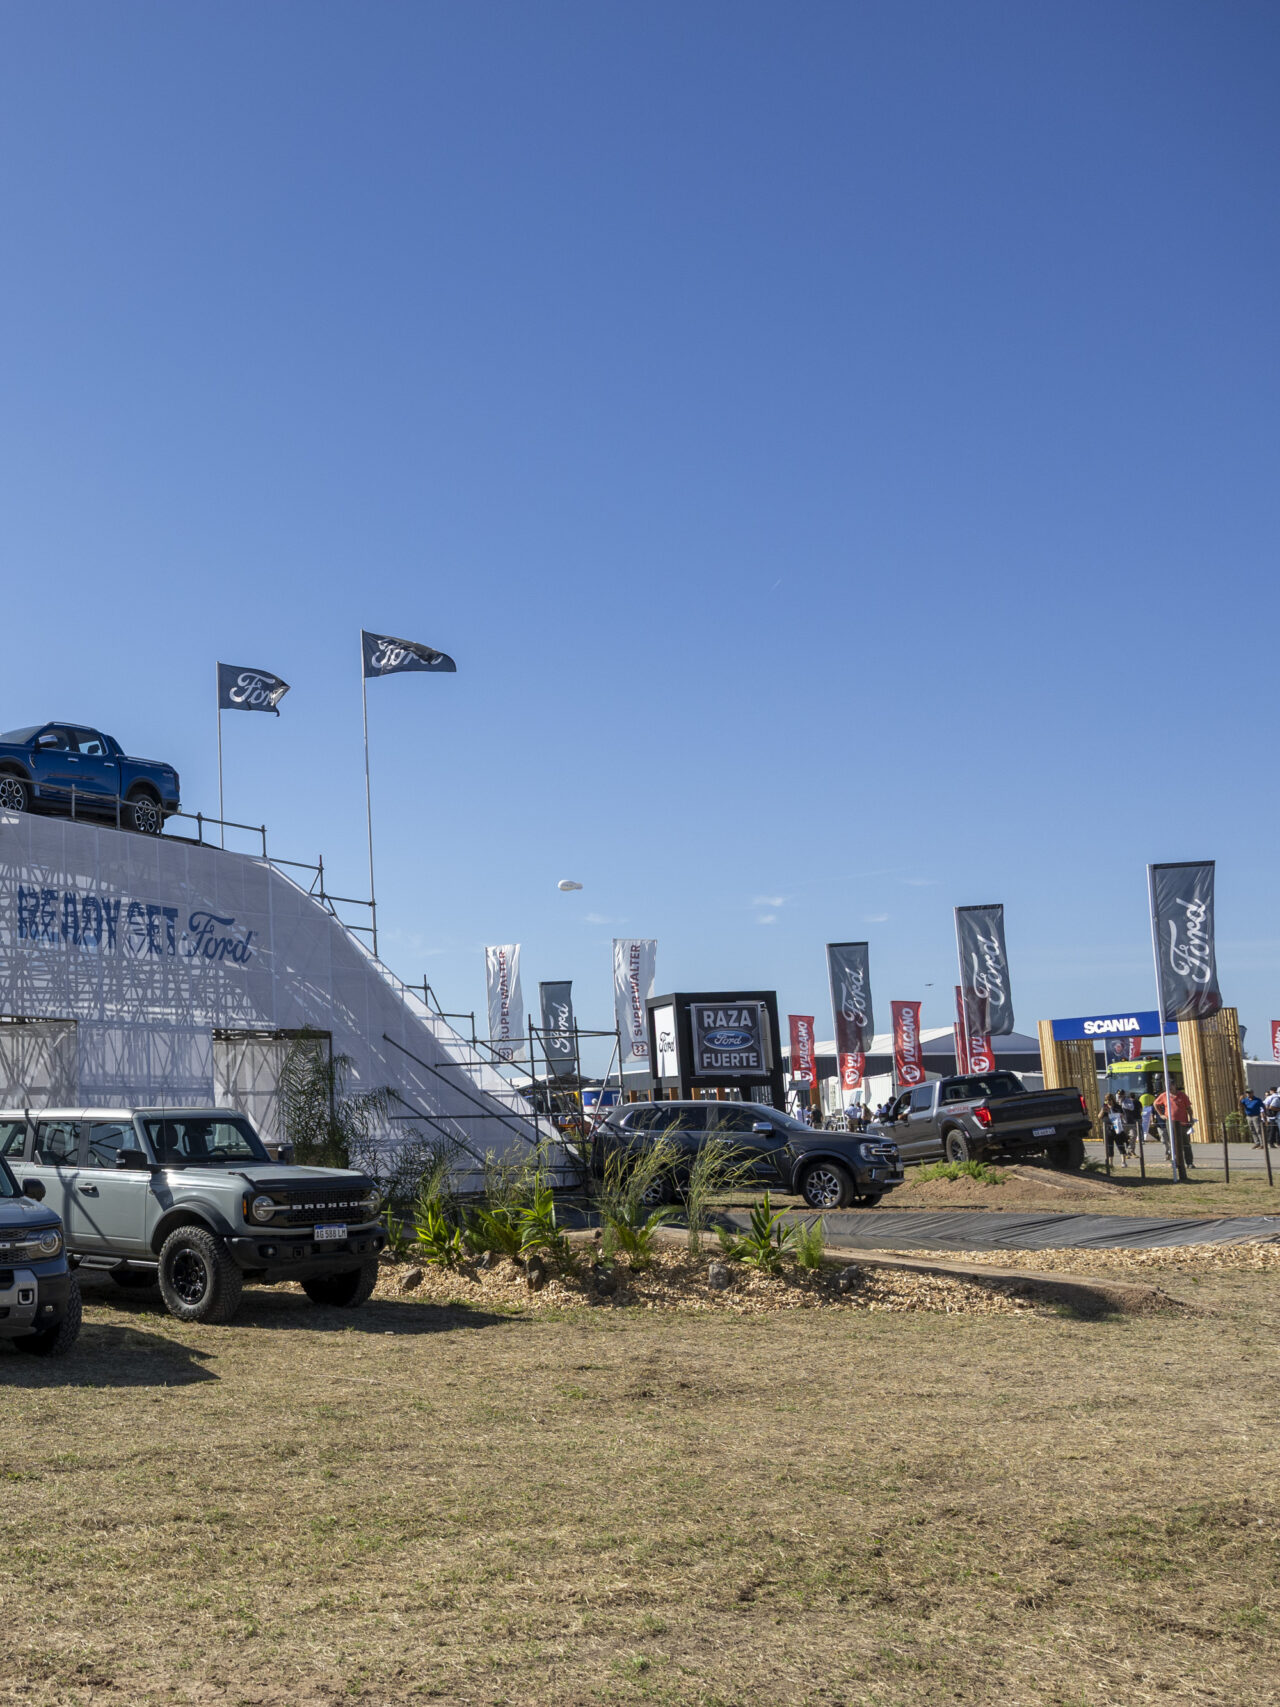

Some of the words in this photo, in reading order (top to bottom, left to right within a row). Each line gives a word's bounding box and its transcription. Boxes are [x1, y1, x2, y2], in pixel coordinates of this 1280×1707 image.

[17, 885, 121, 949] READY
[127, 902, 179, 956] SET
[185, 911, 254, 963] Ford
[1169, 897, 1211, 983] Ford
[972, 935, 1005, 1008] Ford
[841, 967, 867, 1027] Ford
[702, 1010, 753, 1028] RAZA
[901, 1007, 915, 1063] VULCANO
[1084, 1017, 1140, 1034] SCANIA
[659, 1031, 675, 1053] Ford
[714, 1032, 742, 1045] Ford
[799, 1021, 808, 1068] VULCANO
[703, 1052, 758, 1067] FUERTE
[292, 1201, 358, 1210] BRONCO
